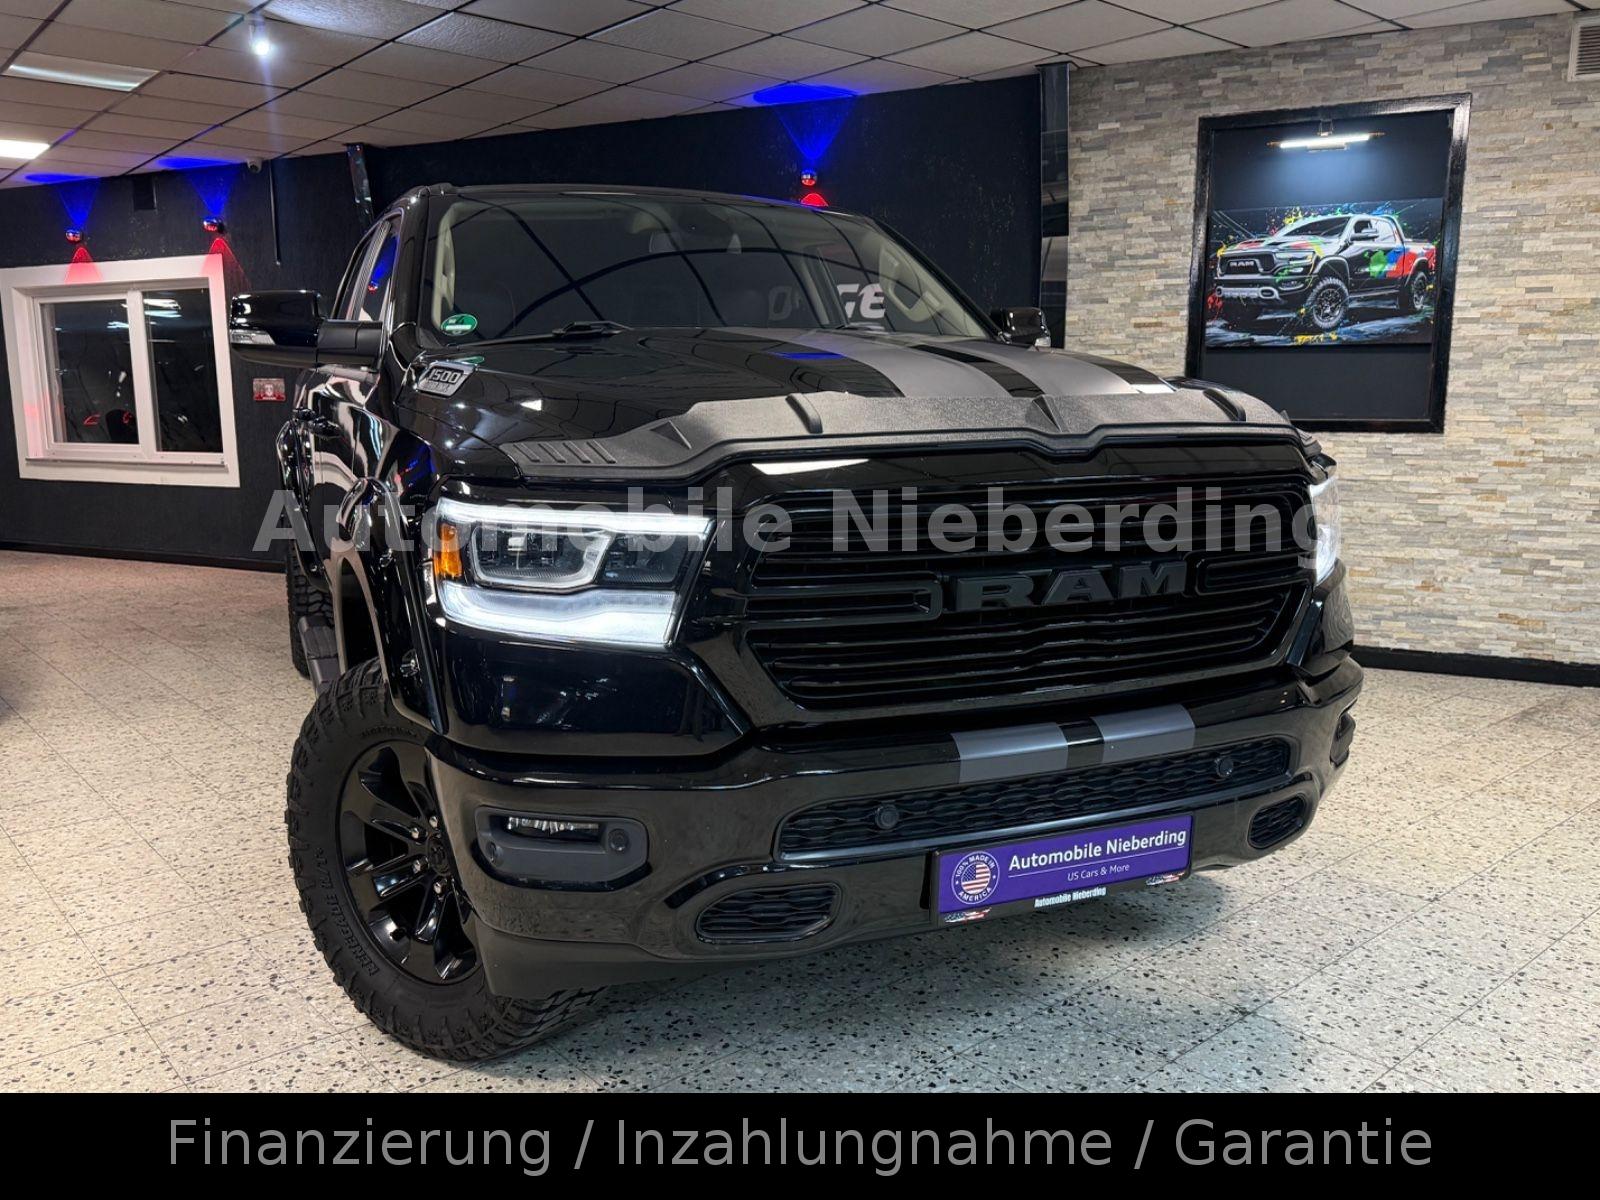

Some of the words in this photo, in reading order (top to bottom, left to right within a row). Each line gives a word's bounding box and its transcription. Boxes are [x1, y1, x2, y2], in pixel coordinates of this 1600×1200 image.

[428, 368, 461, 384] 1500
[957, 561, 1187, 612] RAM
[1008, 842, 1102, 871] Automobile
[1106, 830, 1187, 855] Nieberding
[969, 854, 989, 864] MADE
[987, 859, 996, 869] IN
[1067, 871, 1079, 881] US
[1080, 869, 1099, 879] Cars
[1100, 866, 1108, 876] &
[1109, 864, 1130, 874] More
[958, 886, 992, 901] AMERICA
[1034, 893, 1072, 908] Automobile
[1072, 886, 1107, 901] Nieberding
